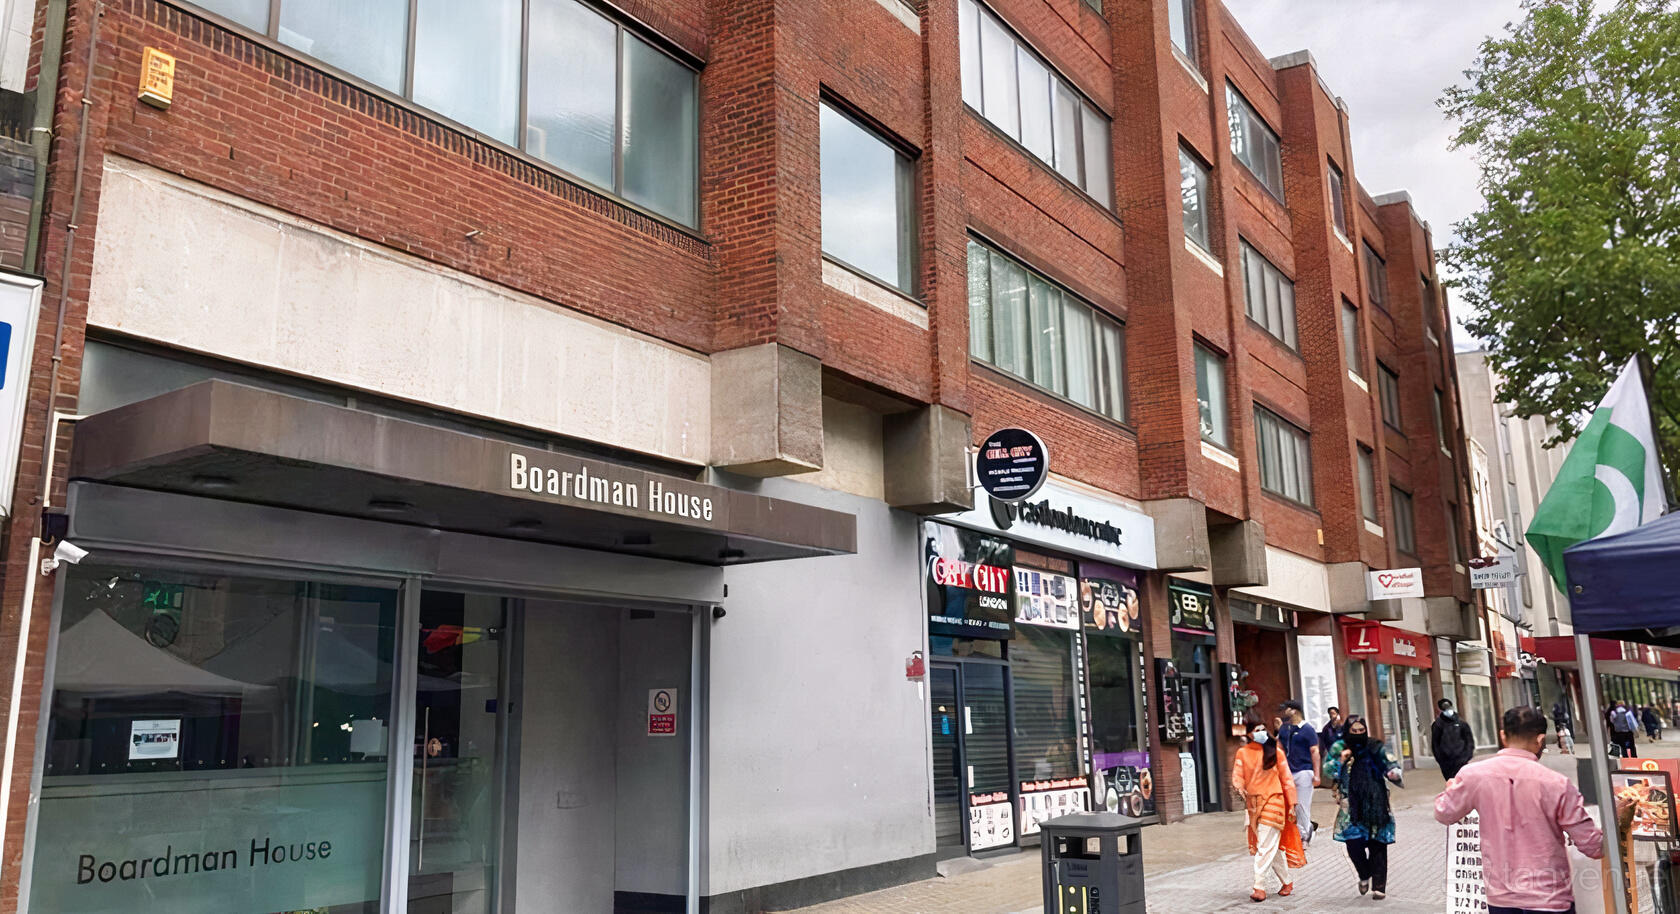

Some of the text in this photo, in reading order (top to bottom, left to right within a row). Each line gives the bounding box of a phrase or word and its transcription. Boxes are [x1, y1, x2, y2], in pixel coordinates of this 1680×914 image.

[510, 453, 713, 522] Boardman House
[974, 564, 1009, 594] CITY
[77, 837, 332, 885] Boardman House
